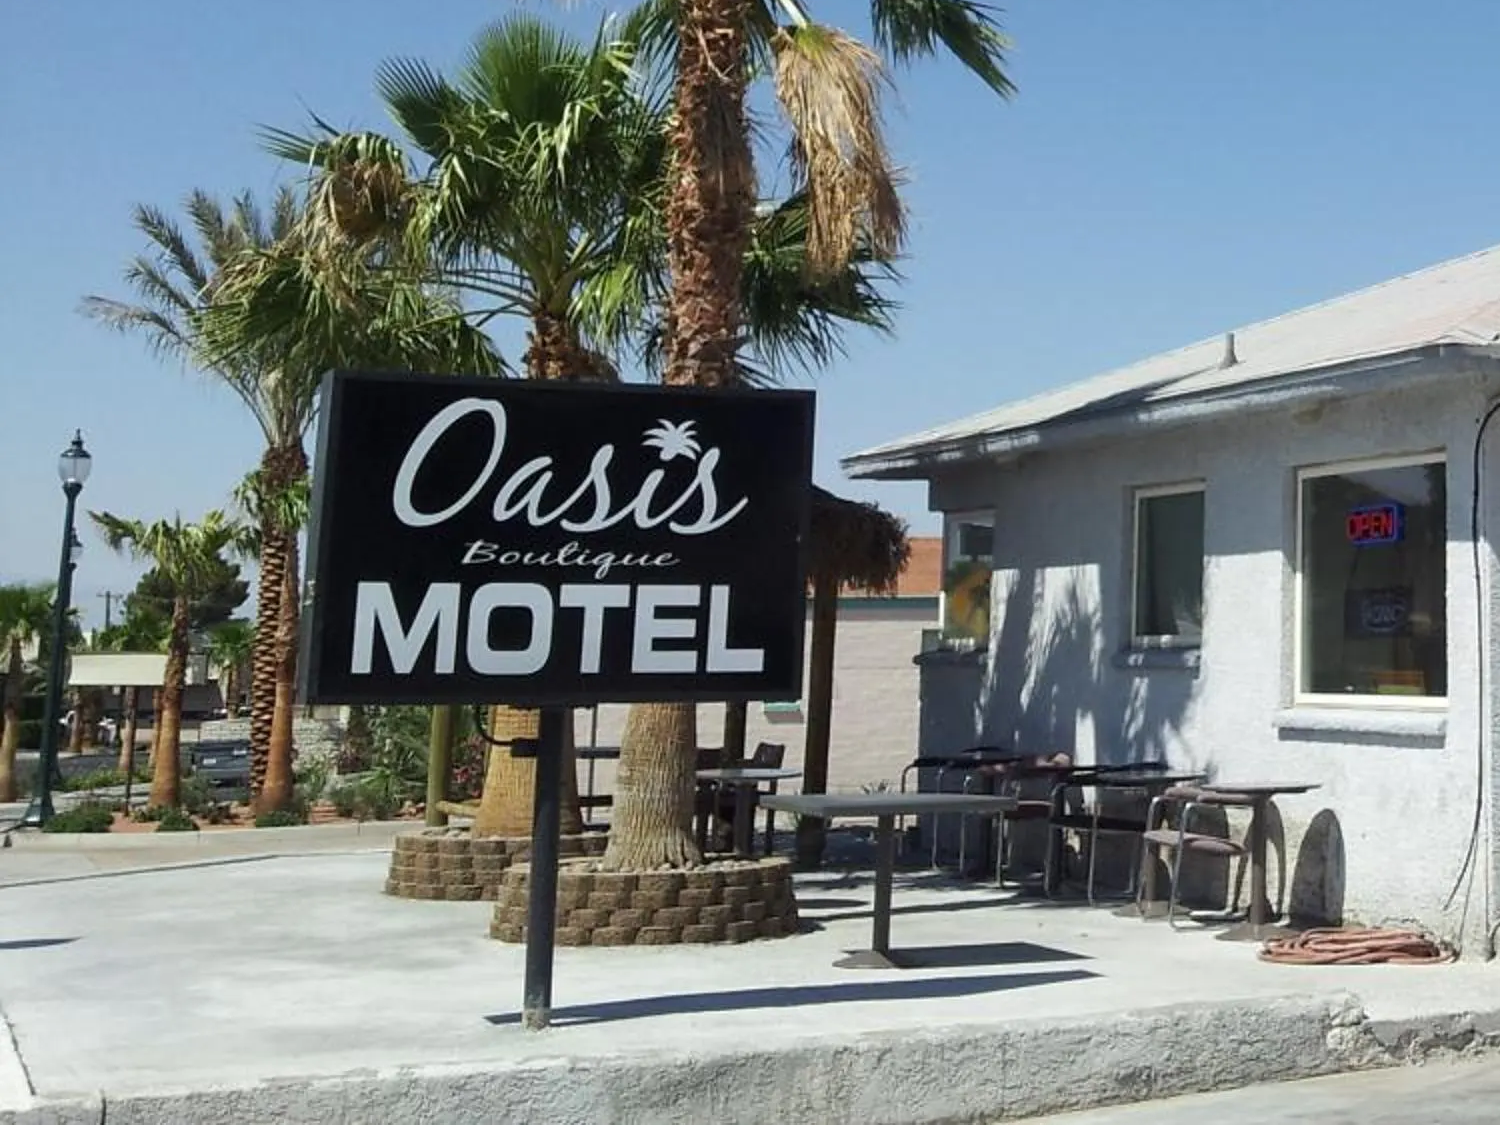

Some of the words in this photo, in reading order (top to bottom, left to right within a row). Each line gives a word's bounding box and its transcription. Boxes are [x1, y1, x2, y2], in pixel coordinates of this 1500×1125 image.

[392, 397, 750, 536] Oasis
[460, 538, 681, 580] Boutique
[1346, 510, 1394, 540] OPEN
[351, 581, 766, 676] MOTEL
